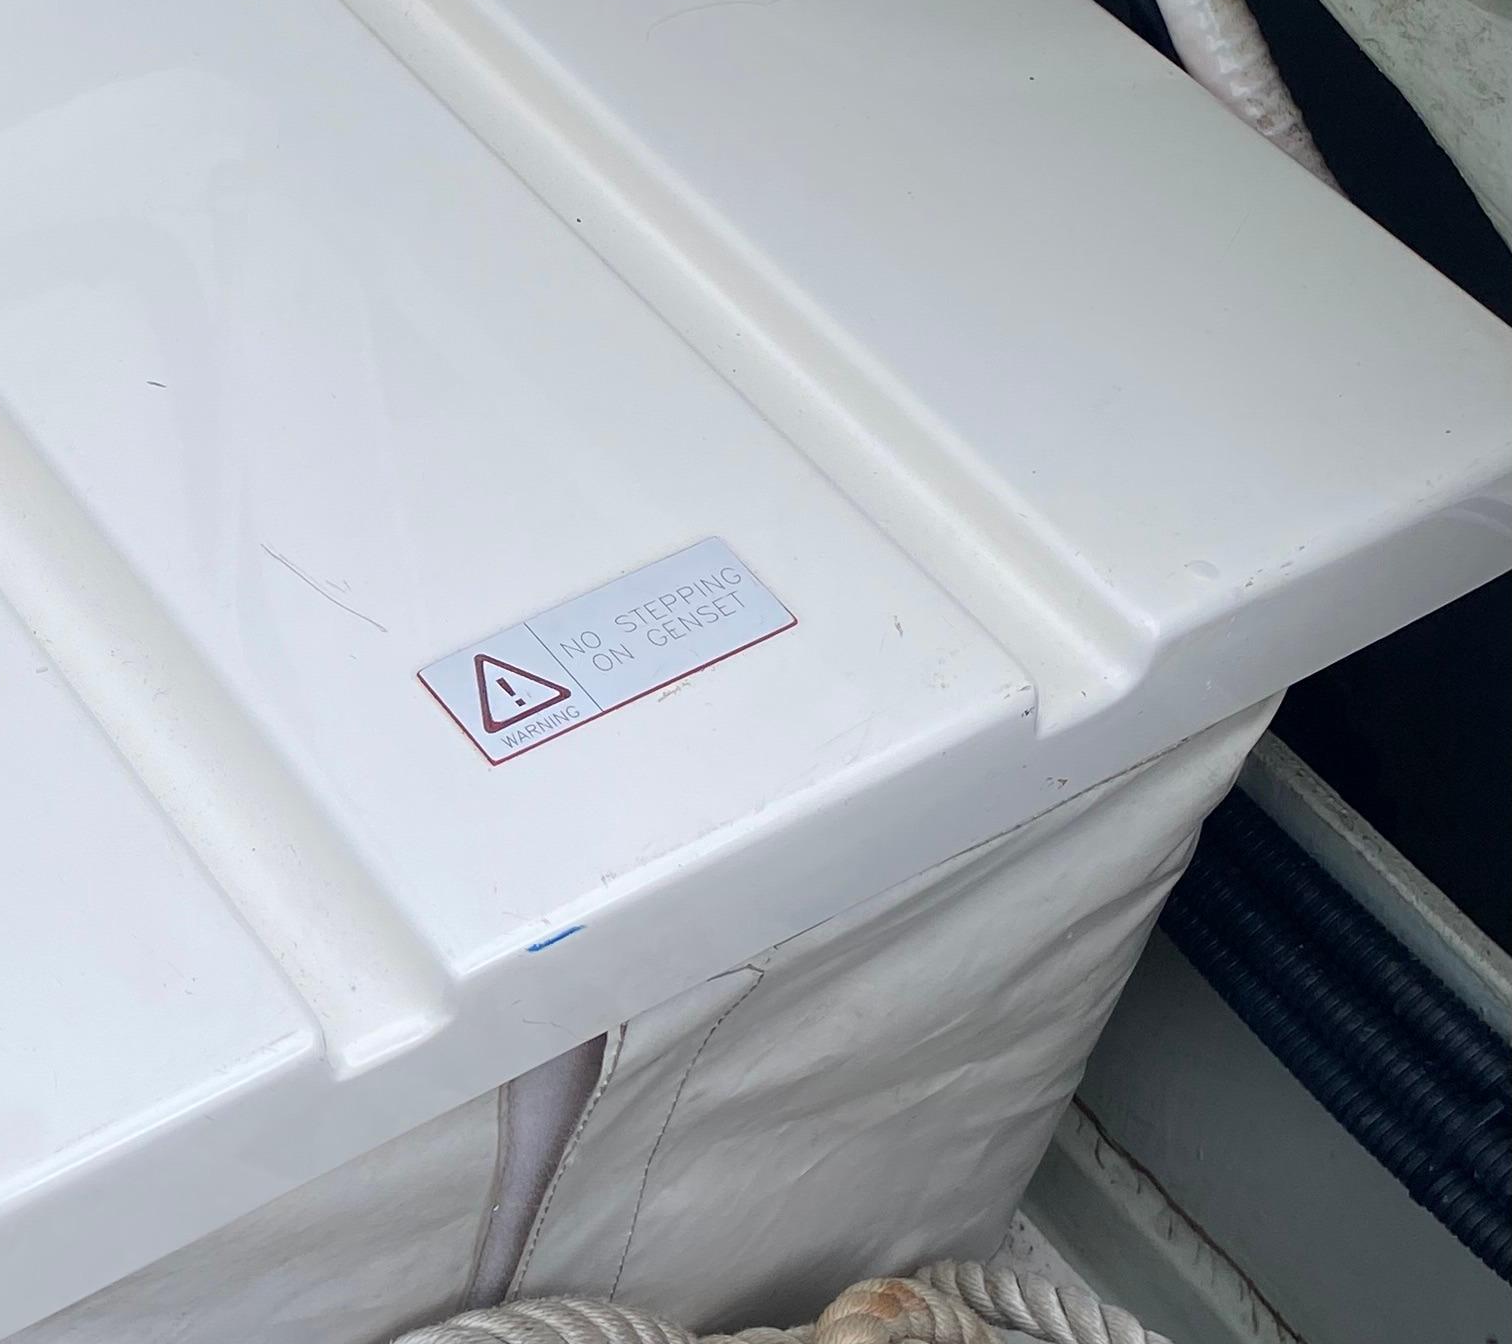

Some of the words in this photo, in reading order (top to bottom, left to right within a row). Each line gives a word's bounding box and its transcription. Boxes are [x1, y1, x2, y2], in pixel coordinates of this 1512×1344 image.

[559, 630, 602, 659] NO
[614, 566, 742, 633] STEPPING
[592, 643, 635, 672] ON
[646, 590, 746, 647] GENSET
[500, 705, 581, 749] WARNING
